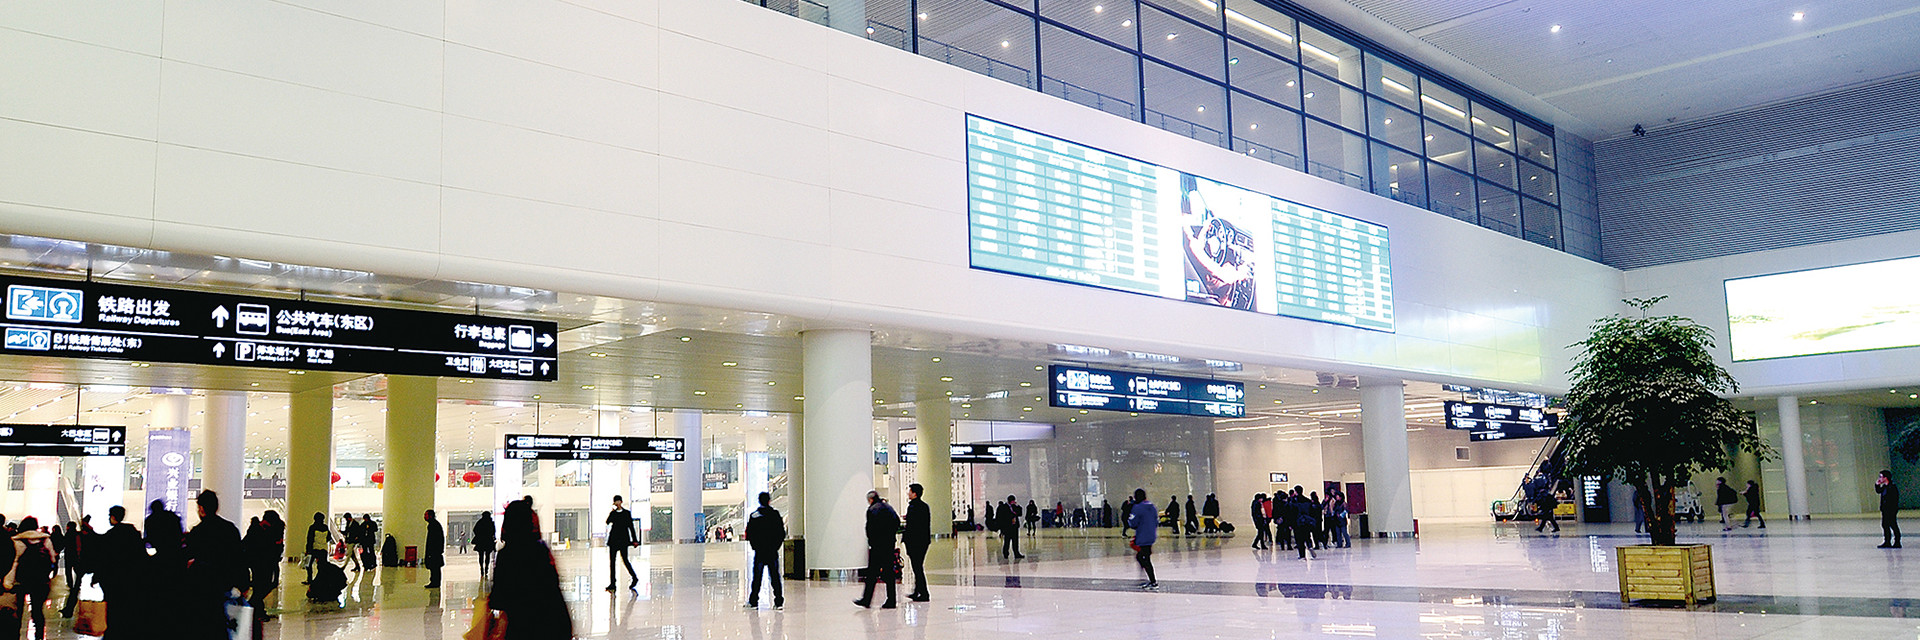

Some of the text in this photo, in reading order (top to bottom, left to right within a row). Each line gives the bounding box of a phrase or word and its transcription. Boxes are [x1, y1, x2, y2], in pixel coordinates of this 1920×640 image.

[98, 295, 171, 317] 铁路出发
[98, 313, 181, 327] Railway Departures
[276, 309, 374, 331] 公共汽车(东区)
[454, 323, 506, 341] 行李包裹
[166, 467, 180, 512] 兴业银行
